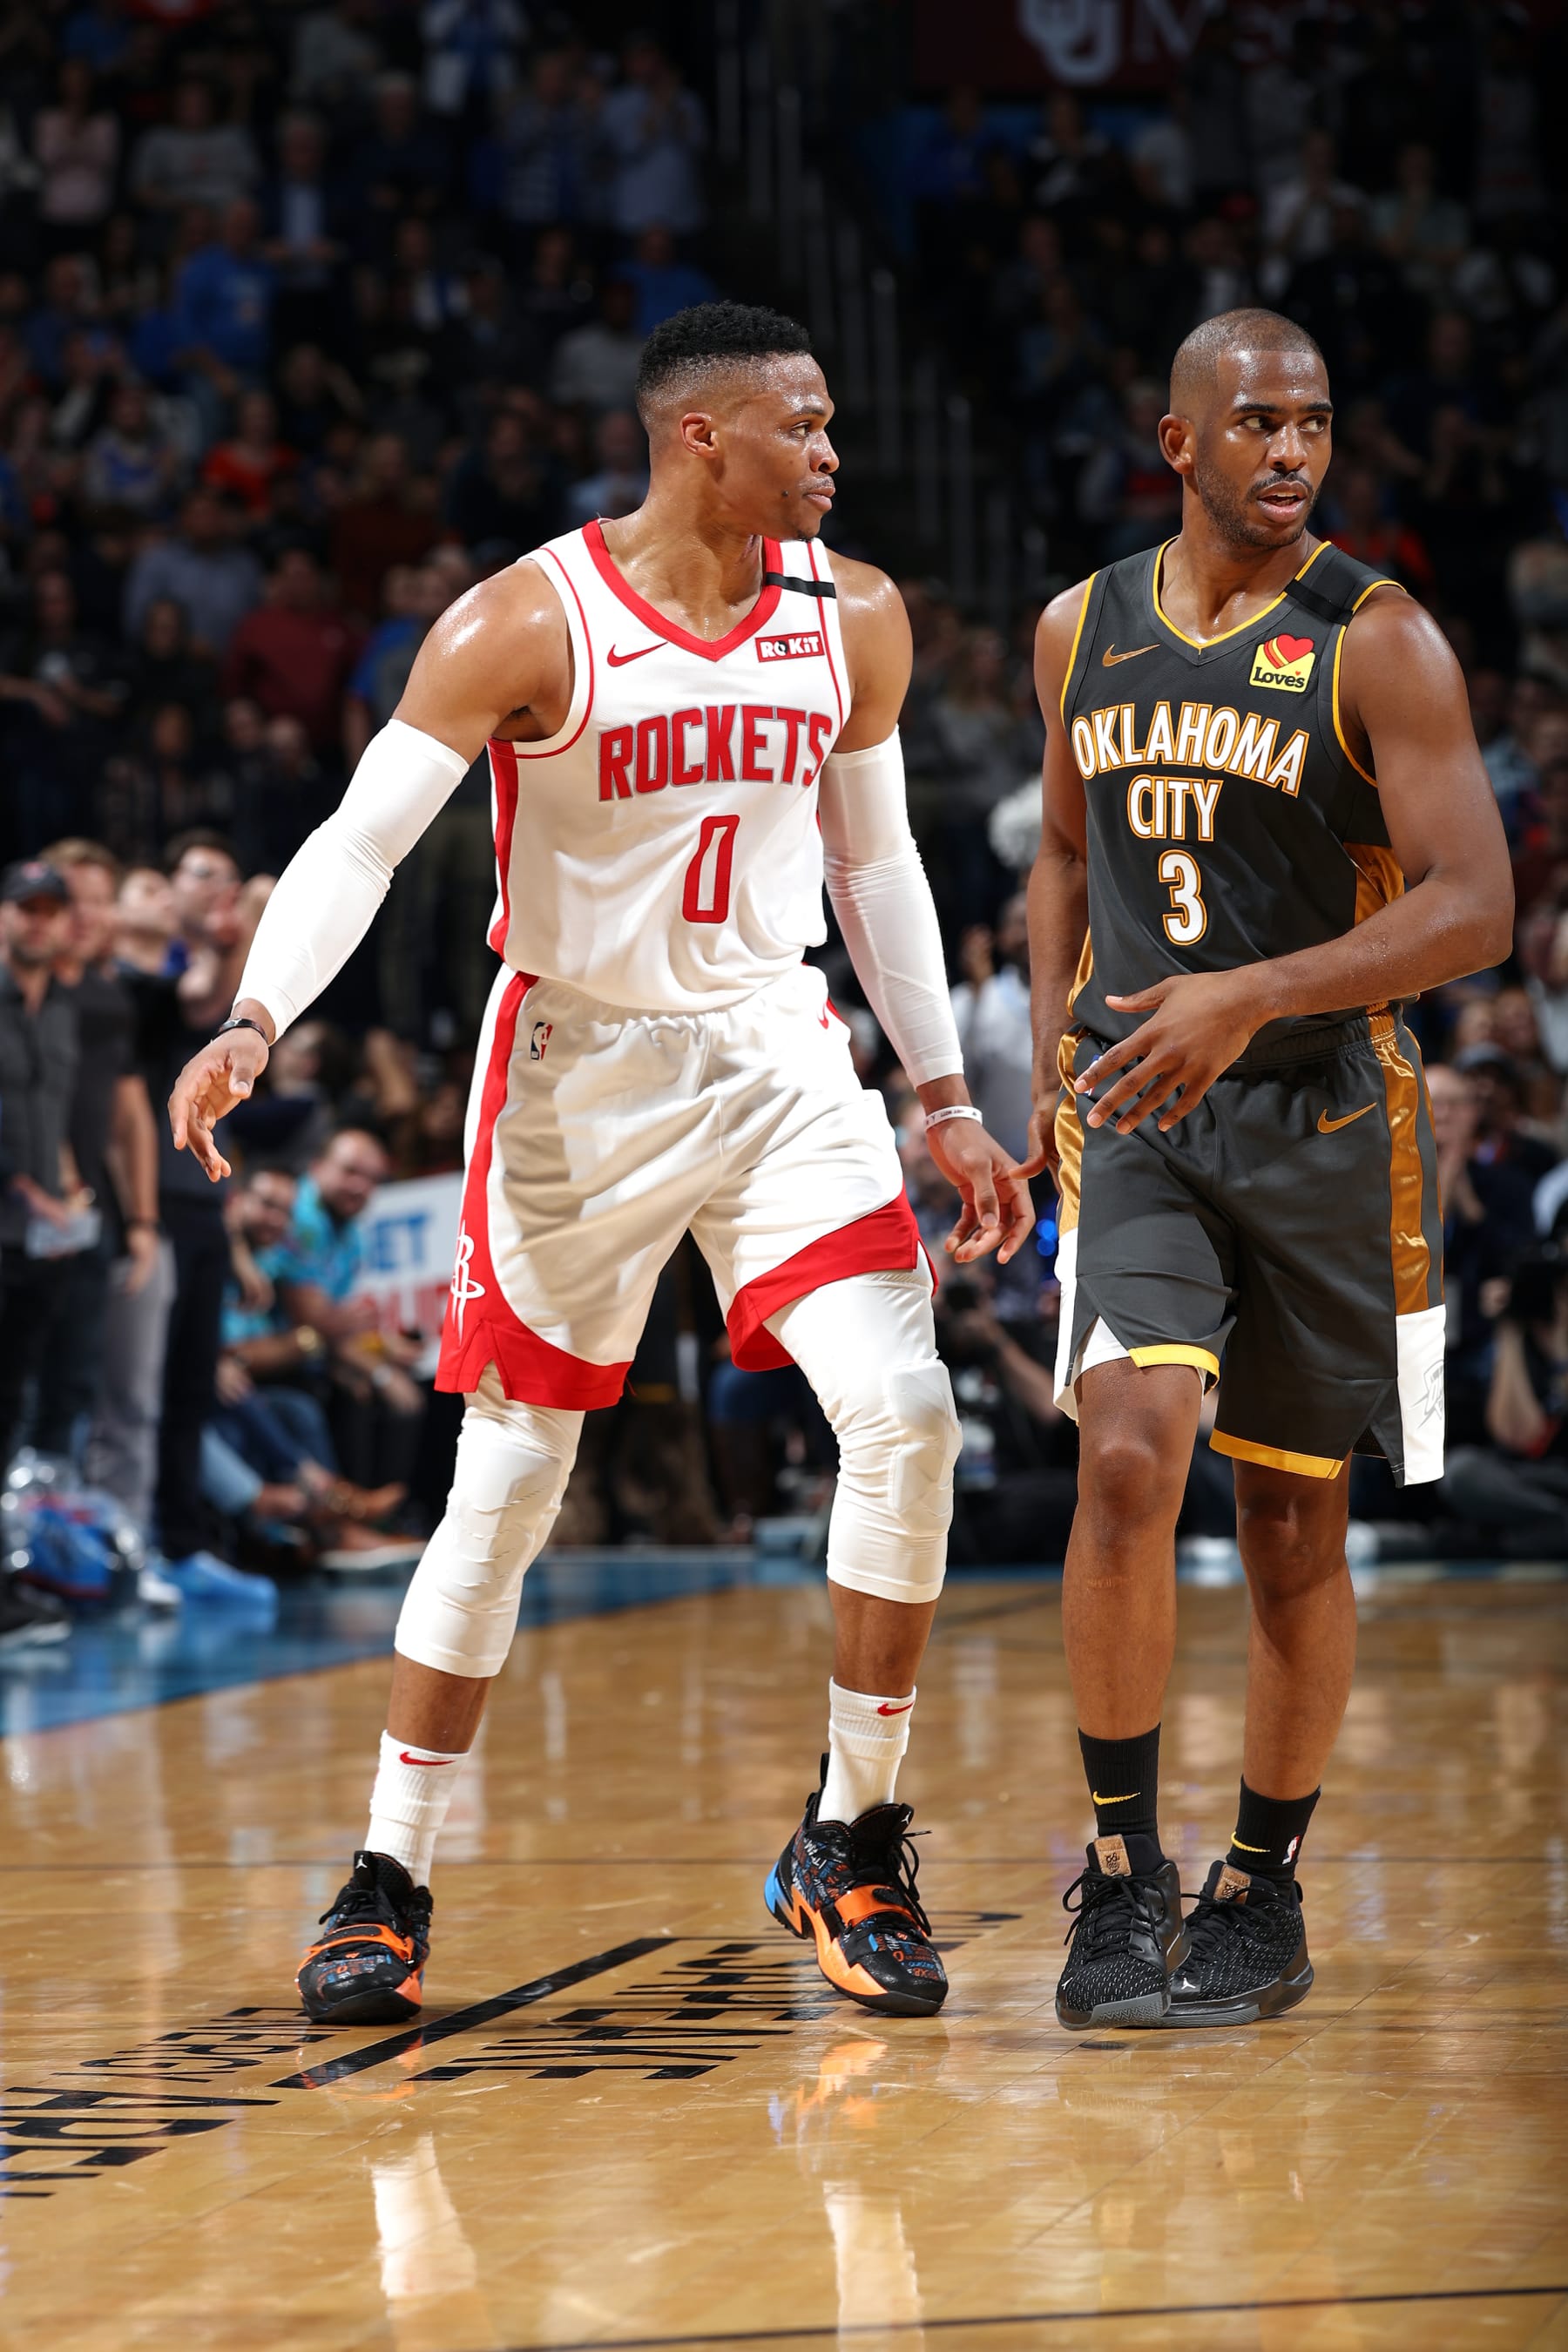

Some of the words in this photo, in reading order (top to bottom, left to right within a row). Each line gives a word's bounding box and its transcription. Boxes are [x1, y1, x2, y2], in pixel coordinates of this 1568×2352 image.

[598, 704, 833, 802] ROCKETS
[1071, 700, 1309, 798] OKLAHOMA
[1126, 774, 1224, 842] CITY
[681, 814, 740, 924] 0
[1158, 848, 1207, 947] 3
